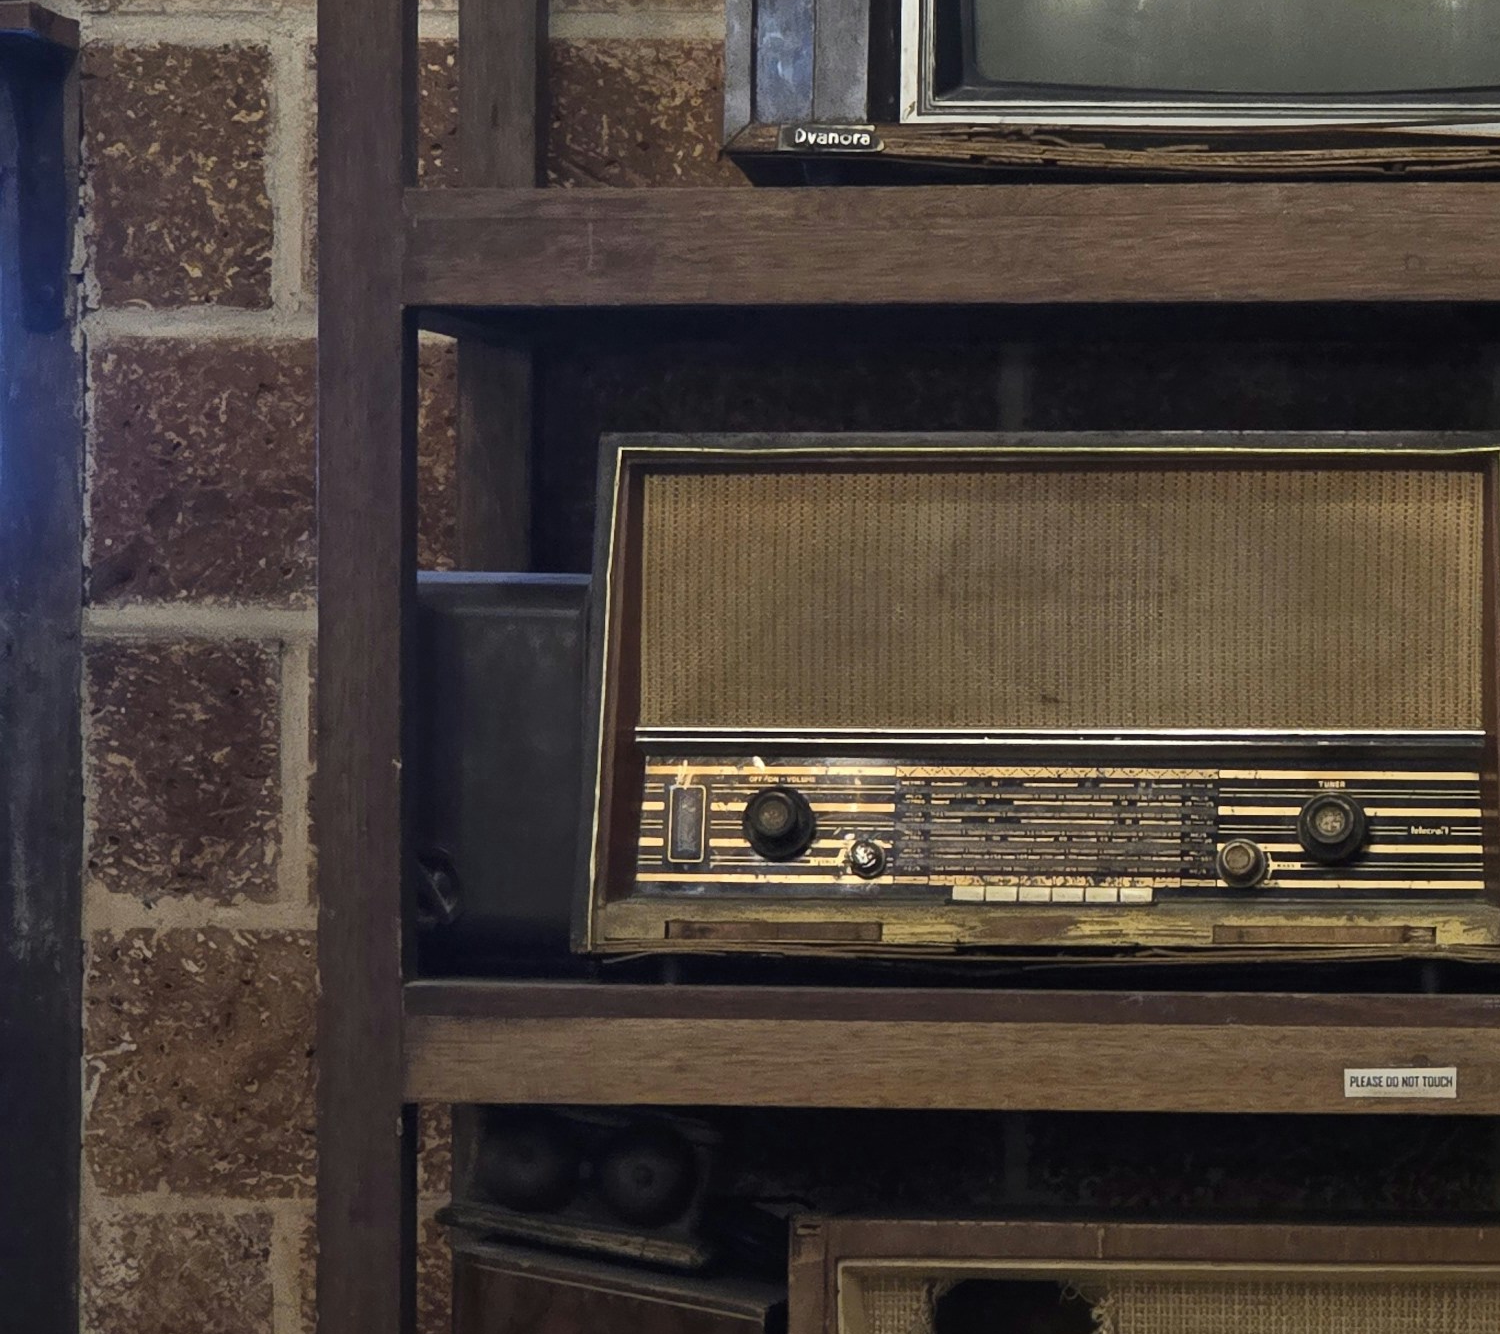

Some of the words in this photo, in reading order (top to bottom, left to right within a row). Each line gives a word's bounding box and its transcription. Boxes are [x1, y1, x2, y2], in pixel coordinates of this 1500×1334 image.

[794, 127, 871, 146] Dvanora
[1349, 1075, 1383, 1088] PLEASE
[1386, 1075, 1399, 1088] DO
[1401, 1075, 1420, 1088] NOT
[1422, 1075, 1453, 1088] TOUCH
